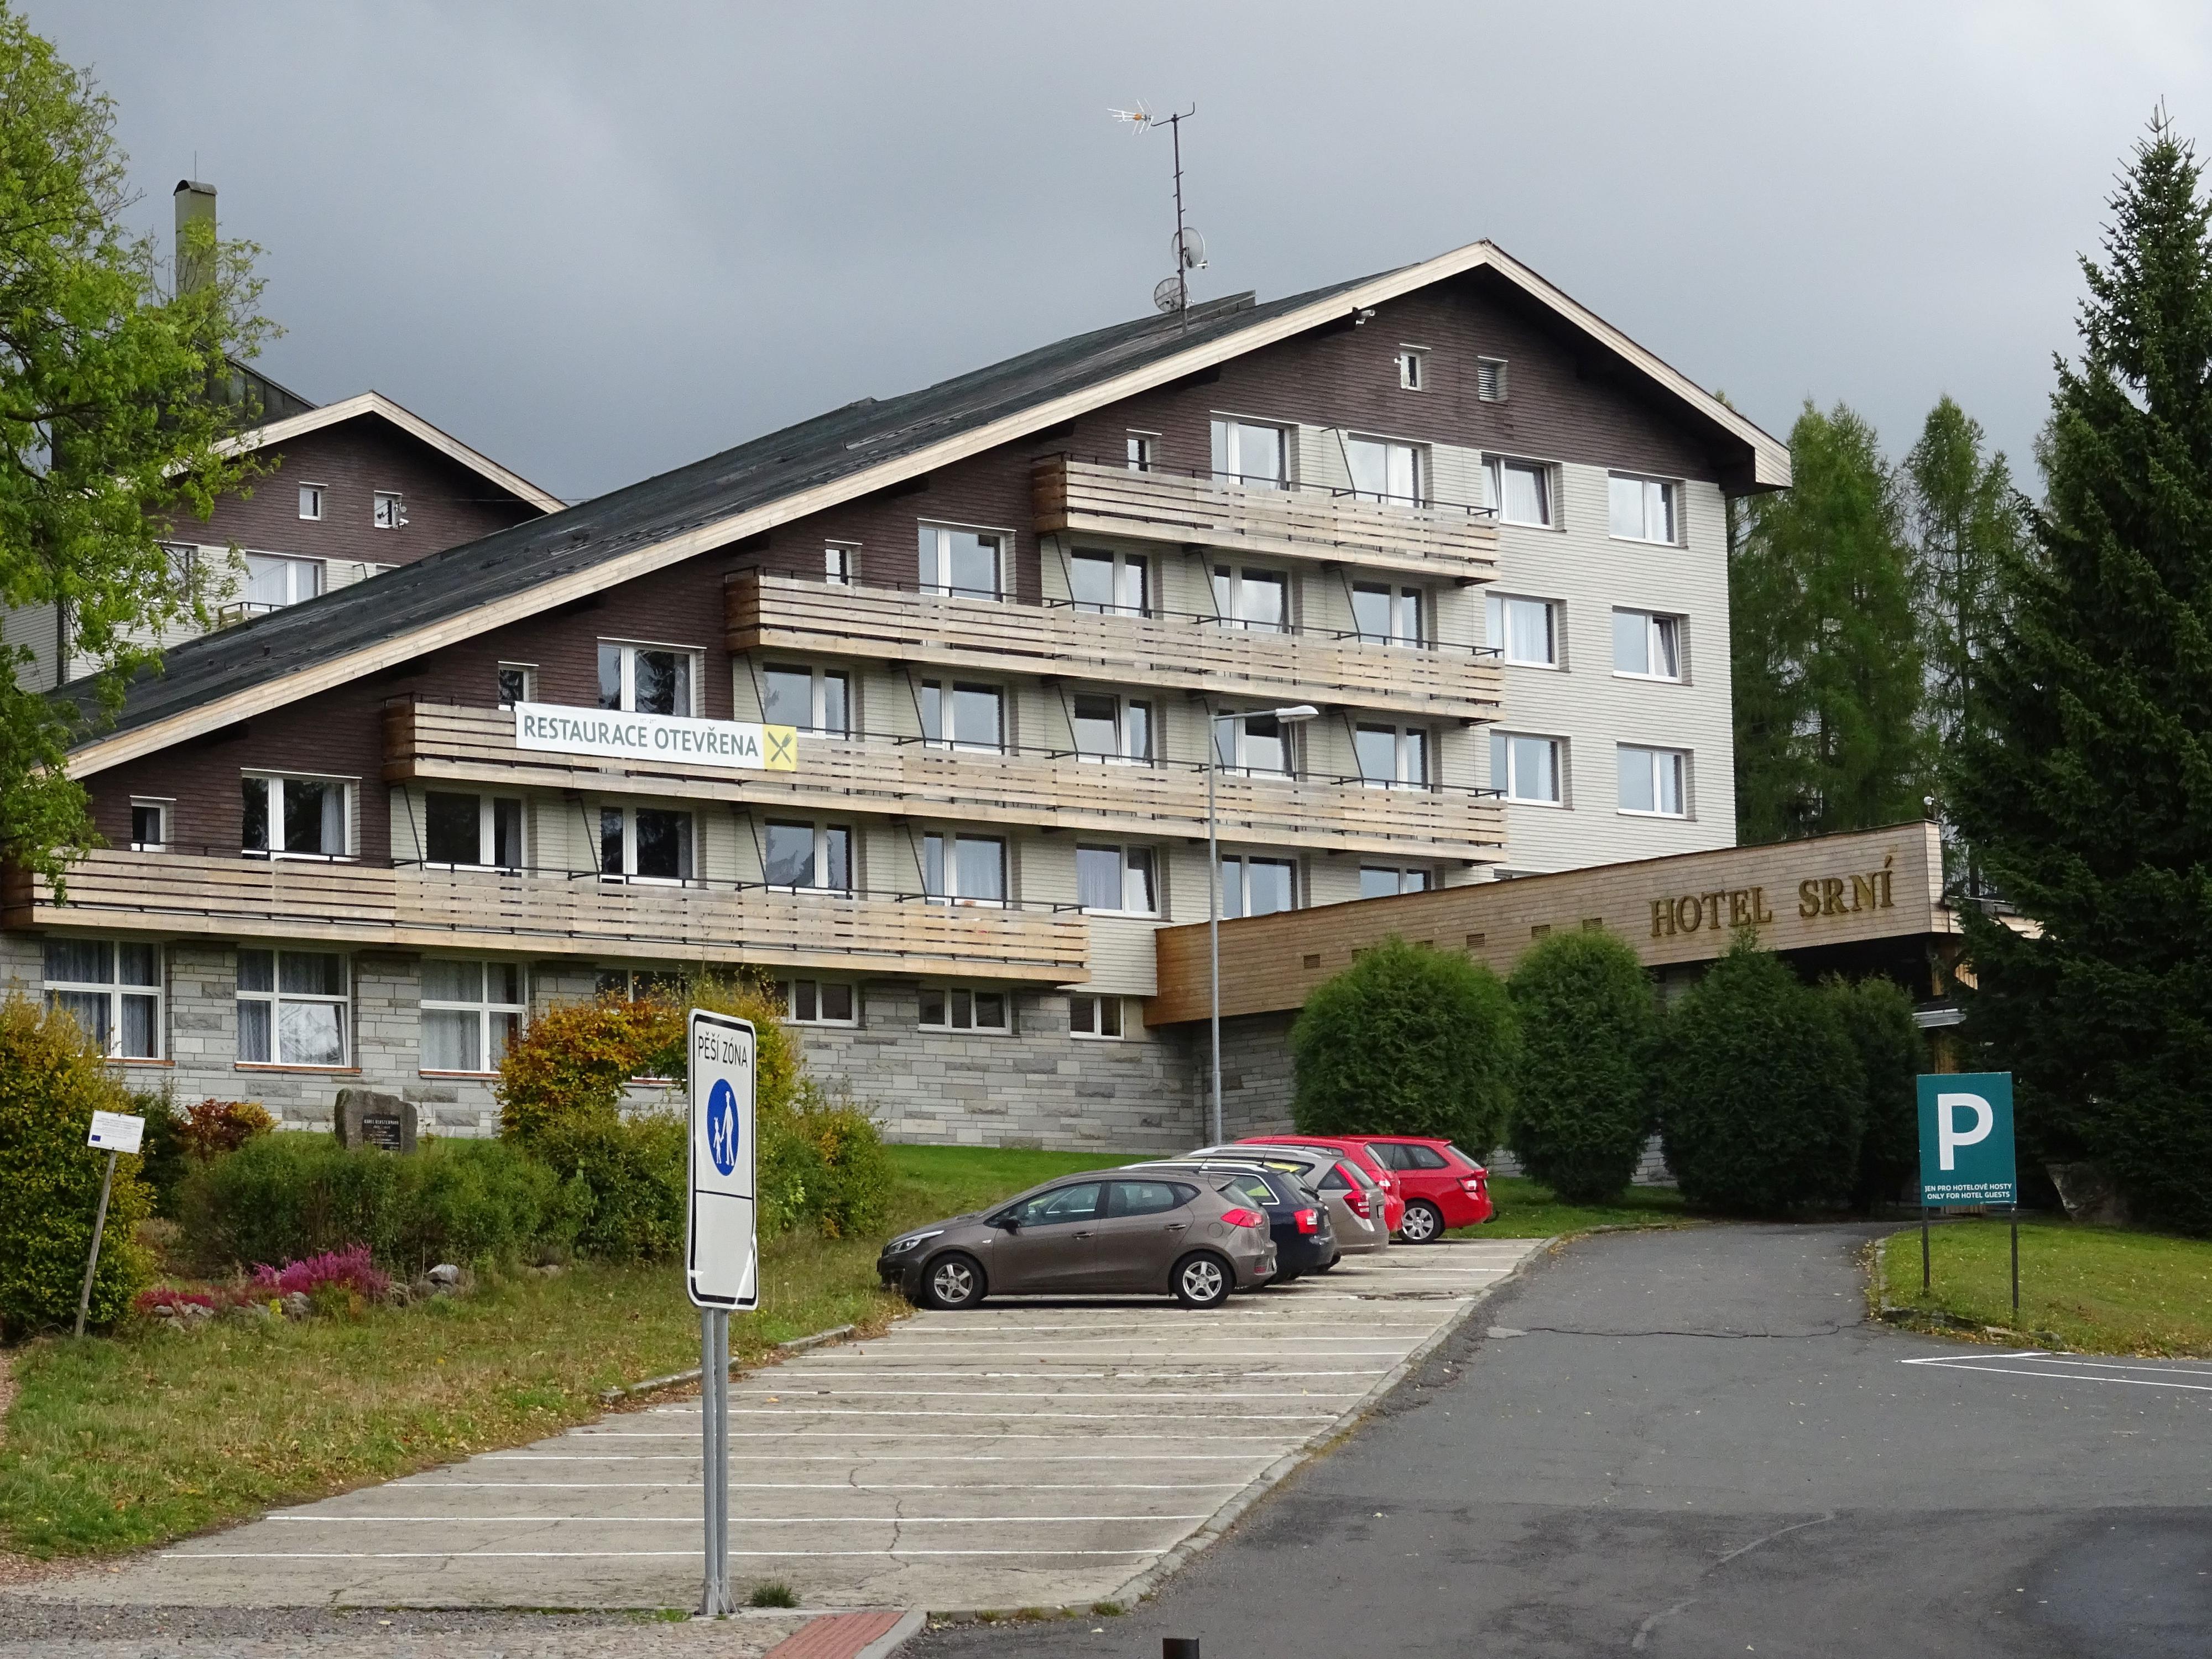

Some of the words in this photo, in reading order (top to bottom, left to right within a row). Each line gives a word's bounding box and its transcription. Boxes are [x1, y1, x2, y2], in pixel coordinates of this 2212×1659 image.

[524, 715, 648, 747] RESTAURACE
[654, 727, 759, 757] OTEVŘENA
[1648, 886, 1772, 937] HOTEL
[1798, 854, 1894, 917] SRNÍ
[698, 1030, 720, 1061] PĚŠÍ
[722, 1036, 748, 1068] ZÓNA
[1938, 1093, 1993, 1170] P
